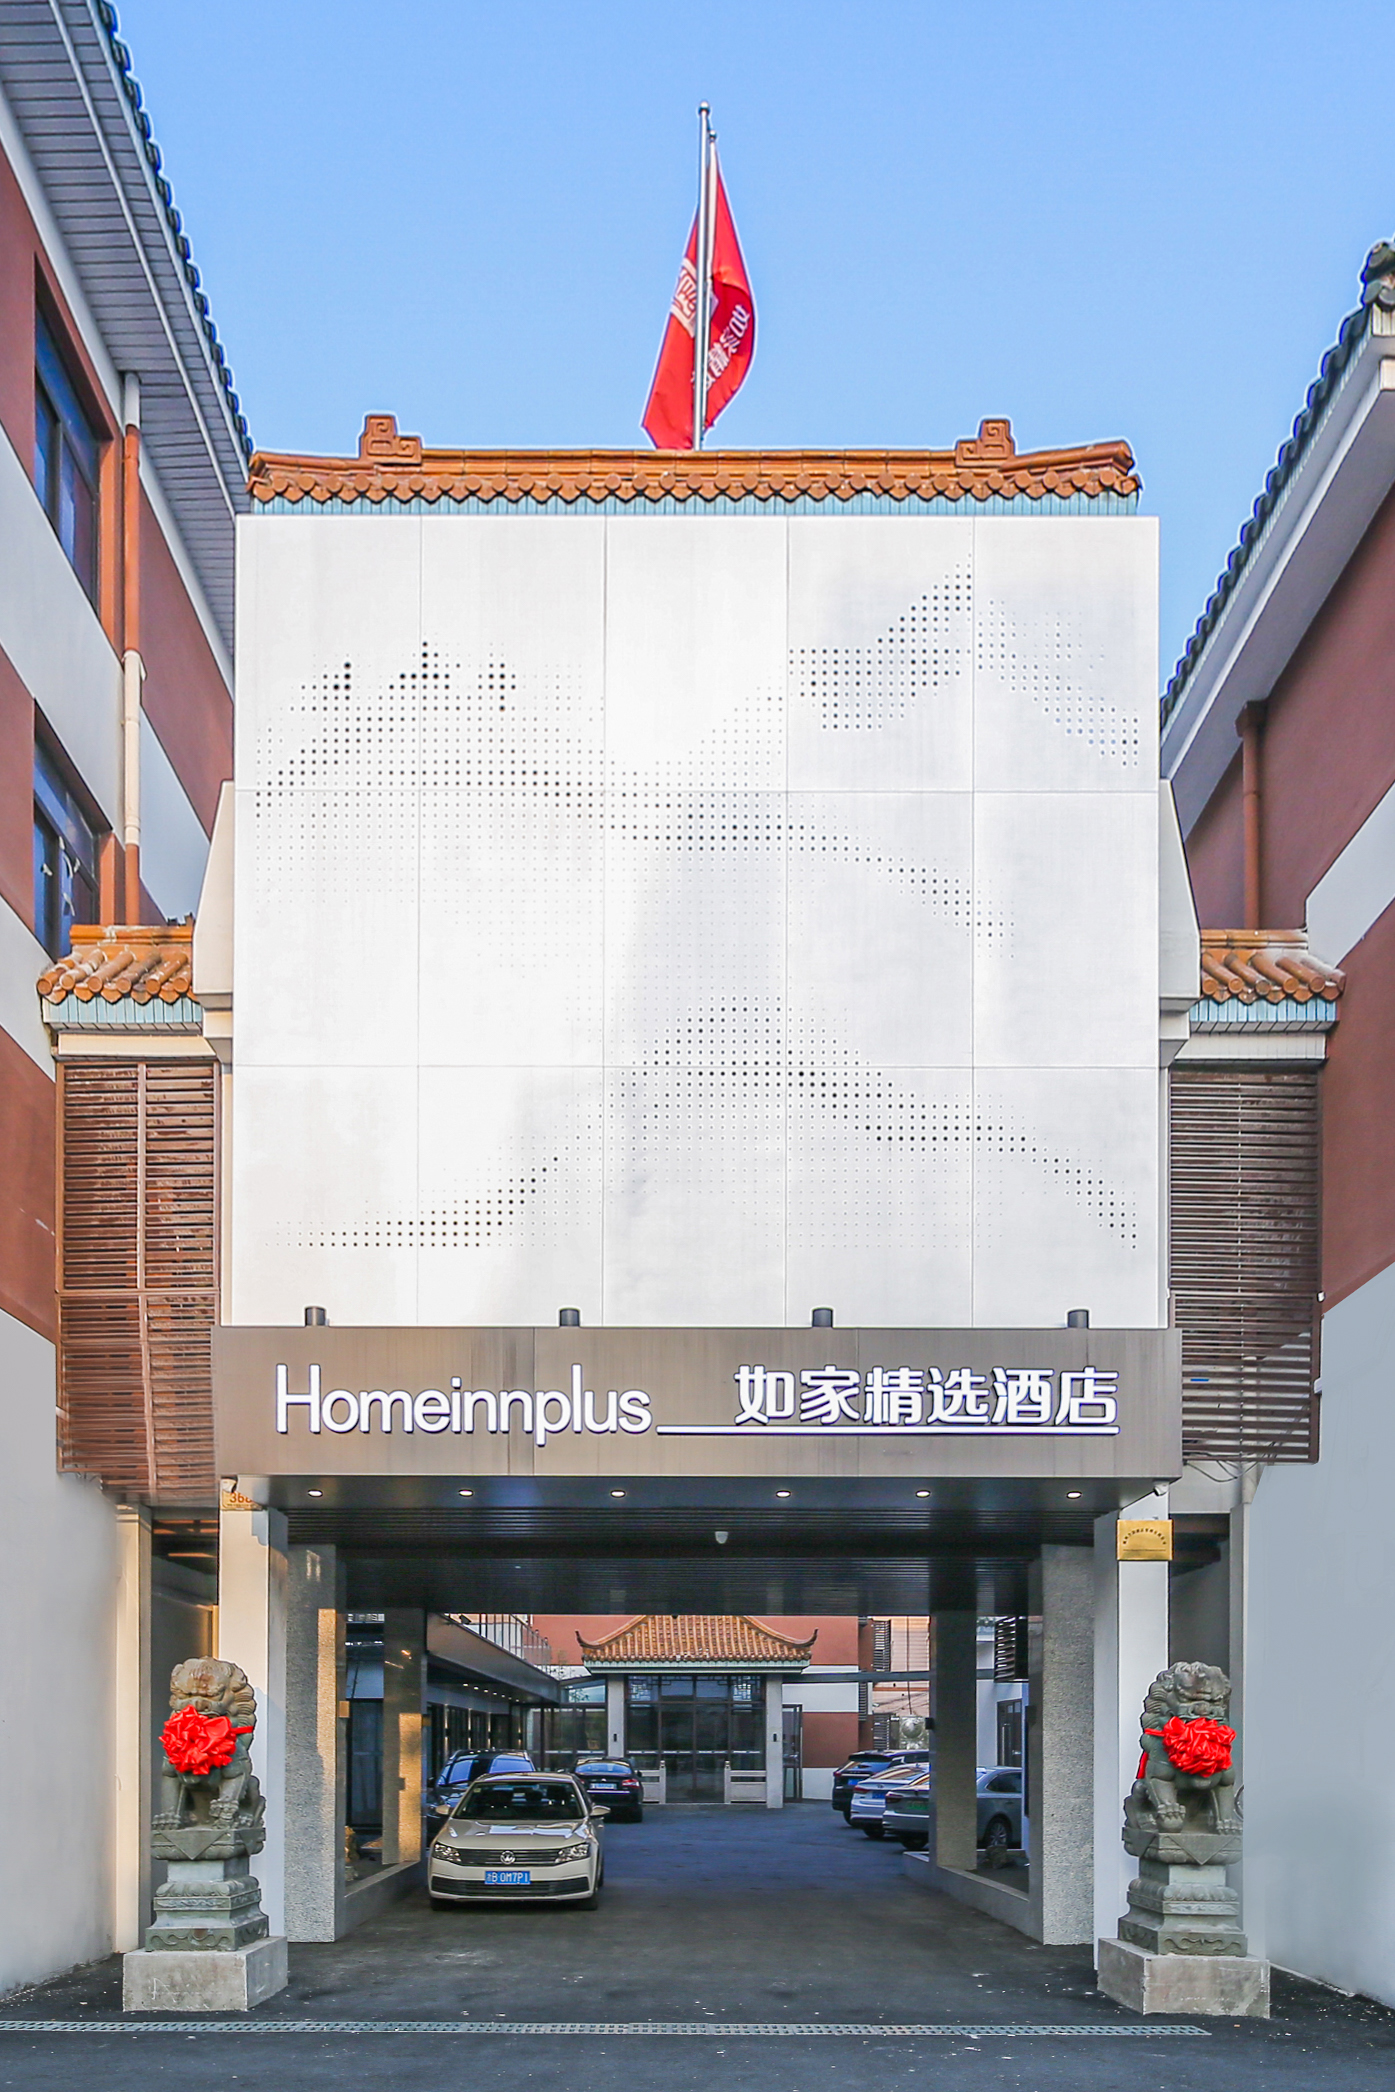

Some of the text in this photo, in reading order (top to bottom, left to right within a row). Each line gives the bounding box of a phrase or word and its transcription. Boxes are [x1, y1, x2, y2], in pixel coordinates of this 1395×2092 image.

[276, 1363, 652, 1447] Homeinnplus
[734, 1364, 1119, 1426] 如家精选酒店
